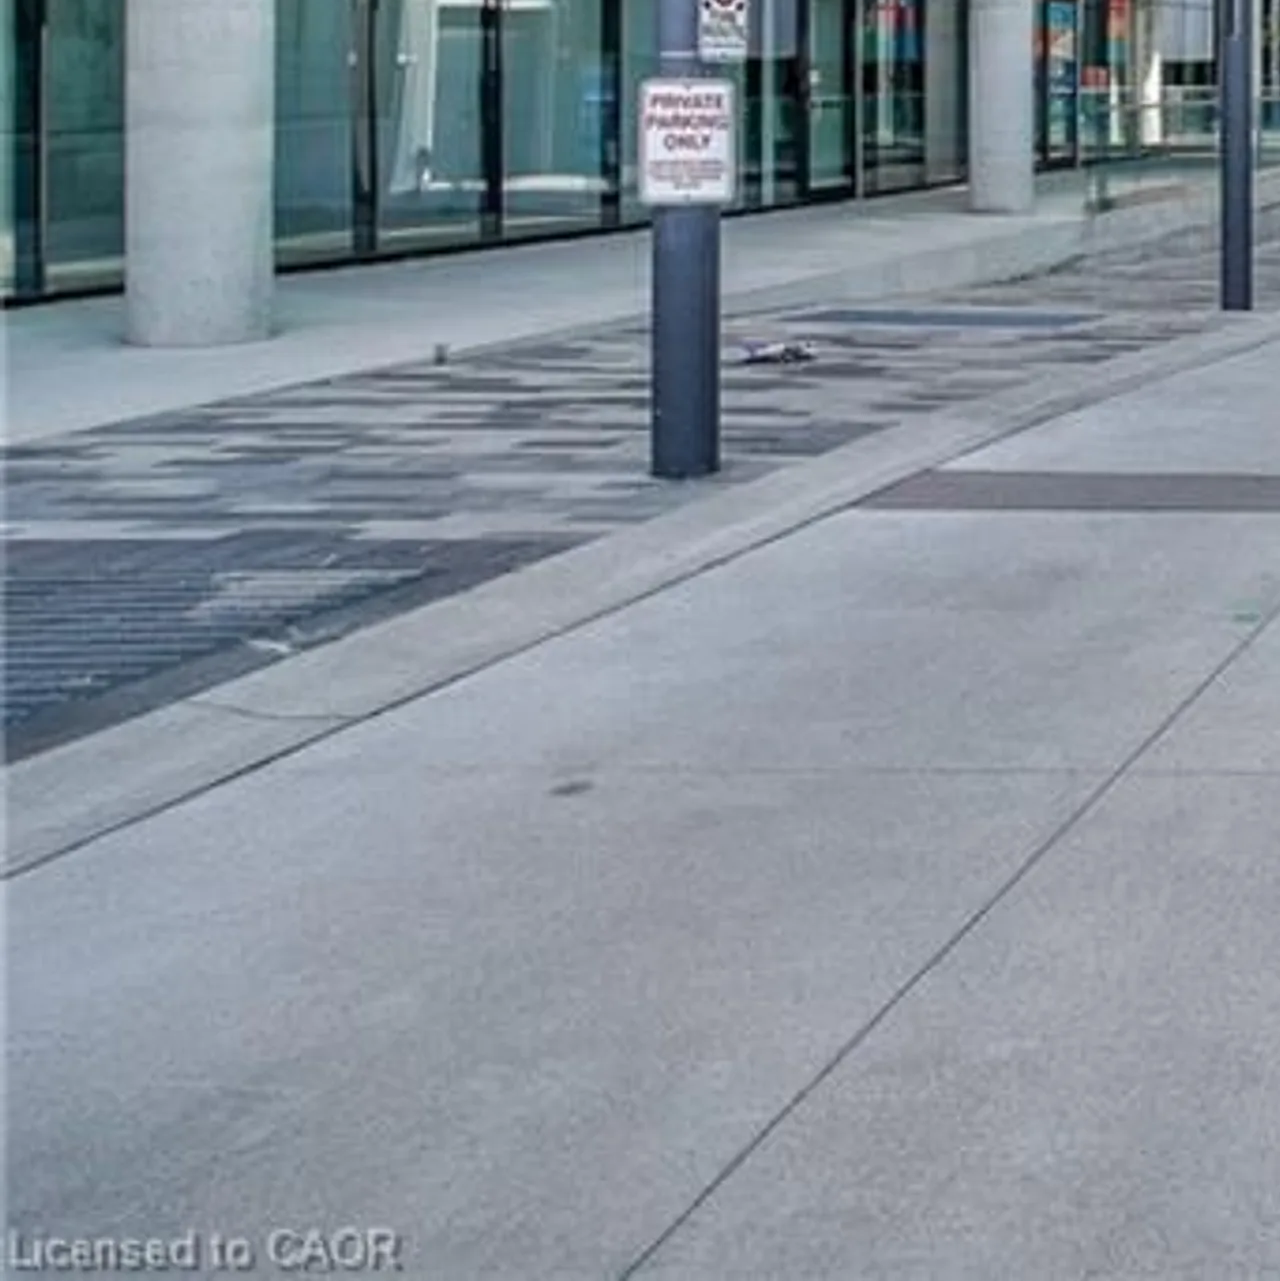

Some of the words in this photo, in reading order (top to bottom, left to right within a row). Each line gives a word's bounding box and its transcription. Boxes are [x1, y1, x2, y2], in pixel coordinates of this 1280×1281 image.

[650, 92, 723, 108] PRIVATE
[645, 114, 730, 130] PARKING
[663, 133, 711, 151] ONLY
